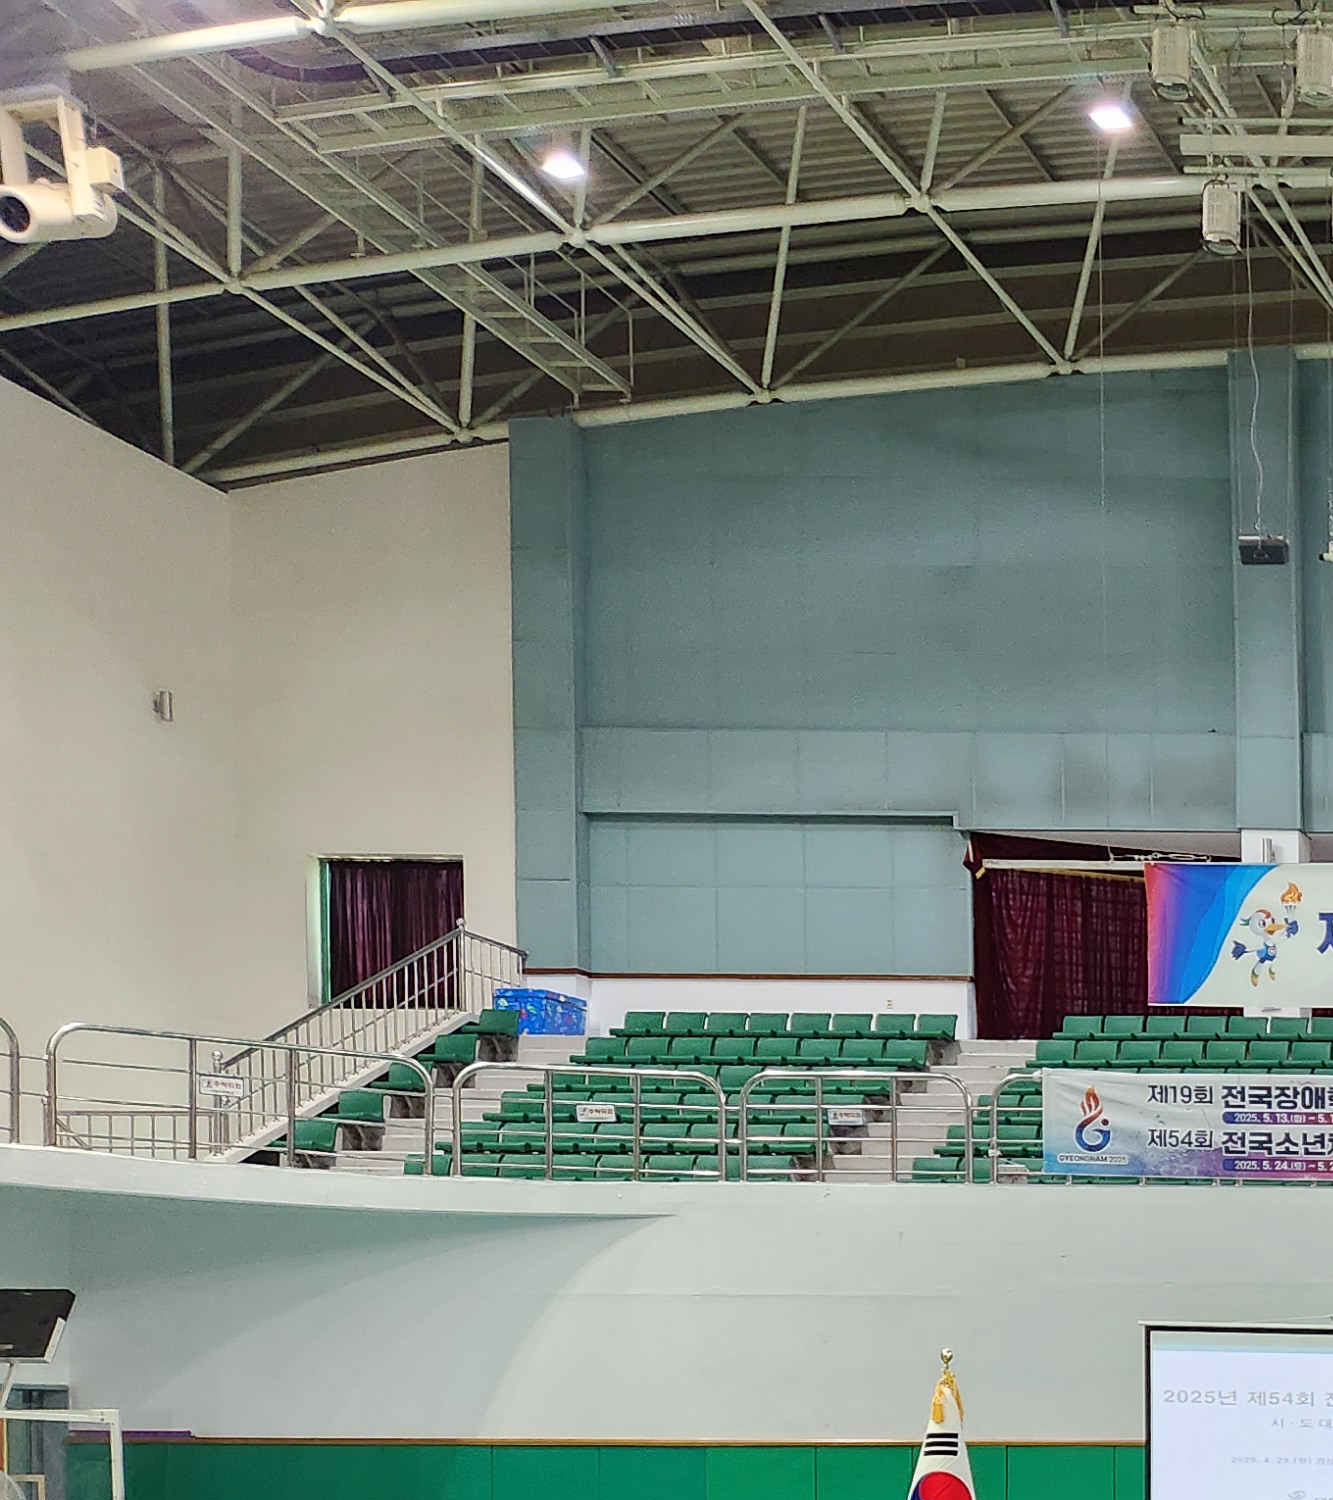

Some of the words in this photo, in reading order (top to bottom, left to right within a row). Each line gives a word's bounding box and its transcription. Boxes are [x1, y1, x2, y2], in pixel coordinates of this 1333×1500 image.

[1147, 1084, 1214, 1105] 제19회
[1147, 1128, 1214, 1149] 제54회
[1162, 1388, 1239, 1407] 2025년
[1246, 1390, 1316, 1408] 제54회
